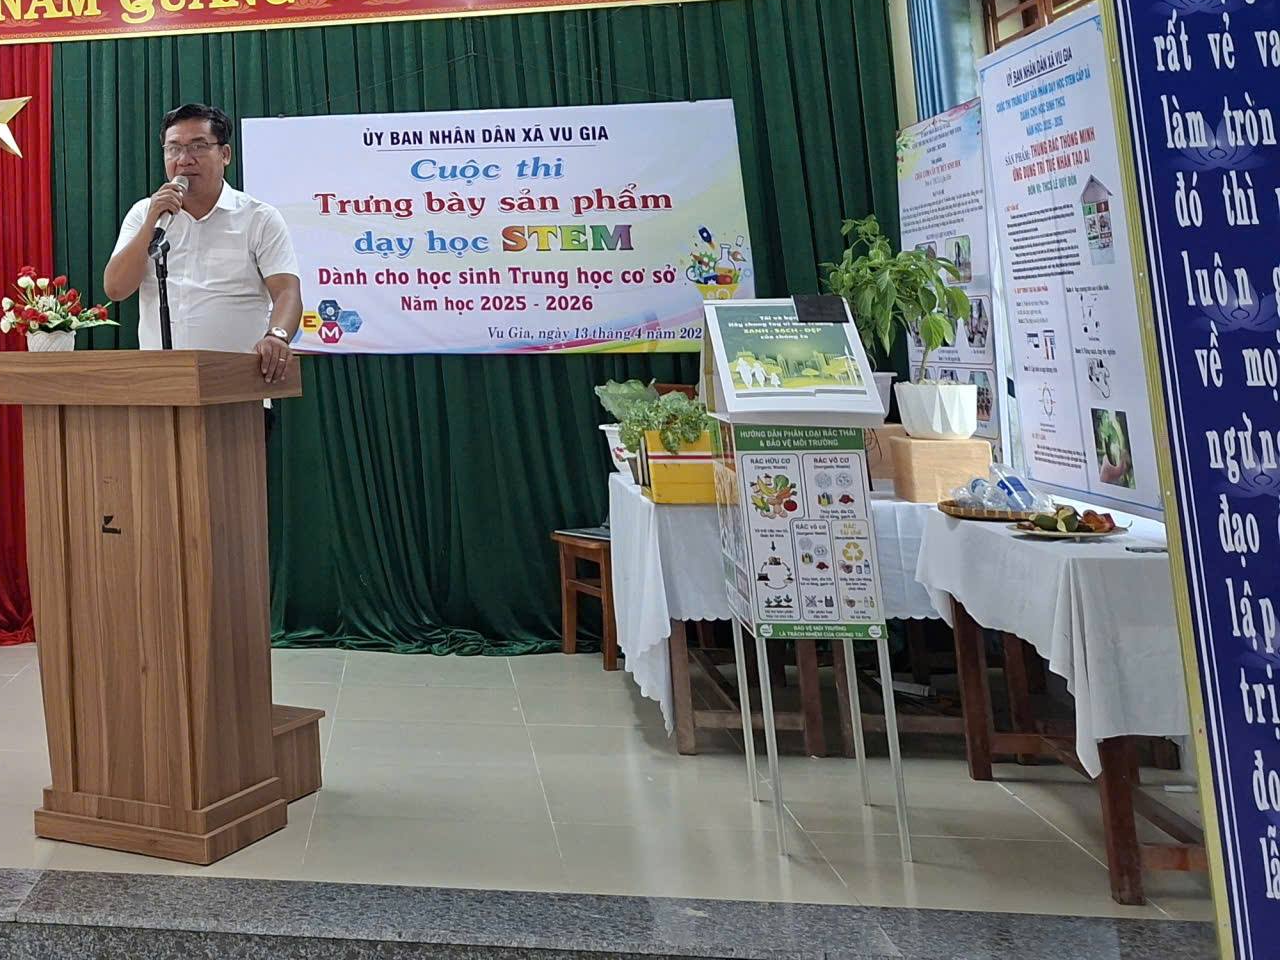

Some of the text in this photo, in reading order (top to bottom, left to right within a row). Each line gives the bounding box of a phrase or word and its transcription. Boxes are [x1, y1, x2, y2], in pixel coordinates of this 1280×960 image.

[1153, 9, 1236, 71] rất vẻ
[363, 124, 609, 146] ỦY BAN NHÂN DÂN XÃ VU GIA
[1160, 91, 1277, 149] làm tròn
[410, 156, 564, 185] Cuộc thi
[313, 182, 673, 219] Trưng bày sản phẩm
[1175, 169, 1260, 227] đó thì
[354, 224, 635, 258] dạy học STEM
[318, 263, 676, 291] Dành cho học sinh Trung học cơ sở
[1181, 249, 1254, 306] luôn
[401, 294, 438, 311] Năm
[445, 295, 474, 316] học
[480, 295, 527, 311] 2025
[546, 295, 593, 310] 2026
[487, 326, 702, 343] Vu Gia, ngày 13 tháng 4 năm 202
[1194, 319, 1224, 387] về
[1219, 493, 1260, 568] đạo
[1225, 577, 1275, 654] lập
